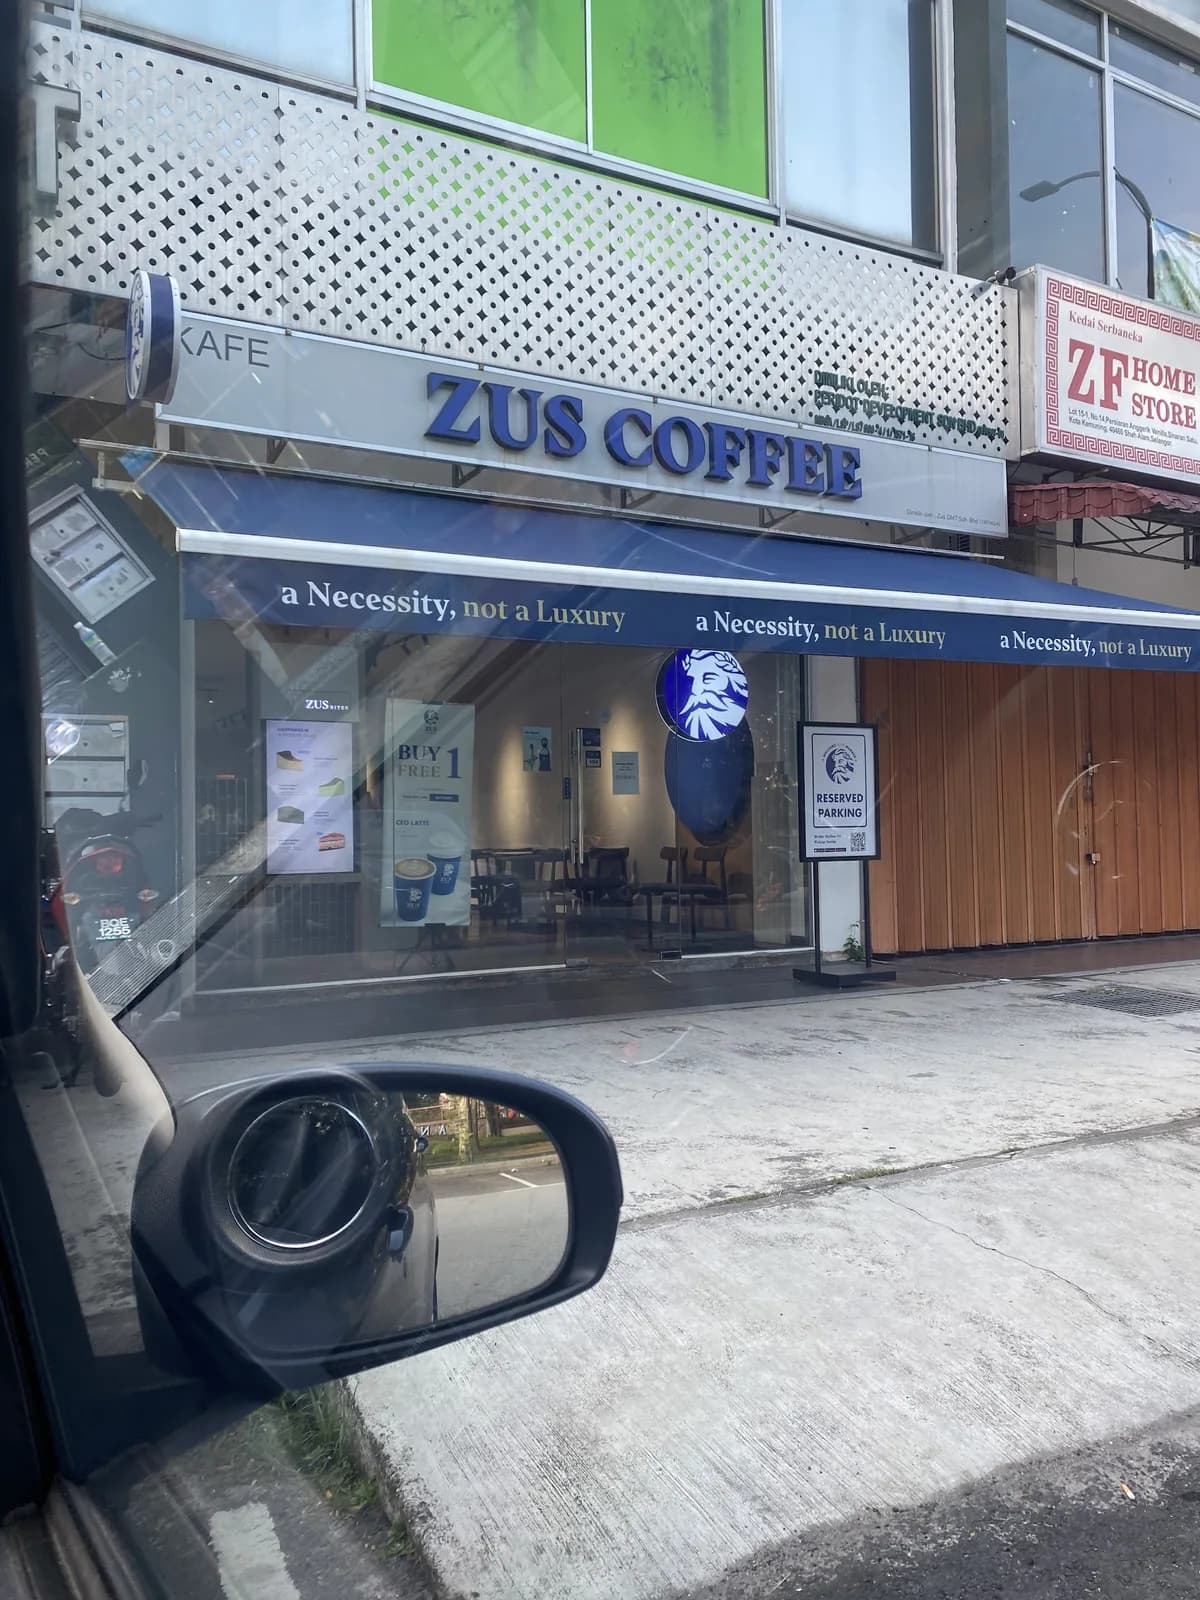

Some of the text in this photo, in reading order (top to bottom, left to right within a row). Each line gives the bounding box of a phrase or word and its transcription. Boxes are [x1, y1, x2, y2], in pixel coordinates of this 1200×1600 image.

[1069, 310, 1143, 343] Kedai Serbaneka
[1068, 338, 1129, 411] ZF
[1131, 356, 1196, 395] HOME
[863, 400, 935, 426] DEVELOPMENT
[1131, 392, 1197, 429] STORE
[424, 372, 862, 501] ZUS COFFEE
[281, 581, 625, 633] a Necessity, not a Luxury
[696, 610, 946, 650] a Necessity, not a Luxury
[1000, 630, 1192, 663] a Necessity, not a Luxury
[305, 699, 329, 710] ZUS
[399, 744, 463, 779] BUY 1
[399, 764, 440, 778] FREE
[816, 793, 864, 803] RESERVED
[818, 808, 863, 818] PARKING
[98, 926, 131, 936] 1255
